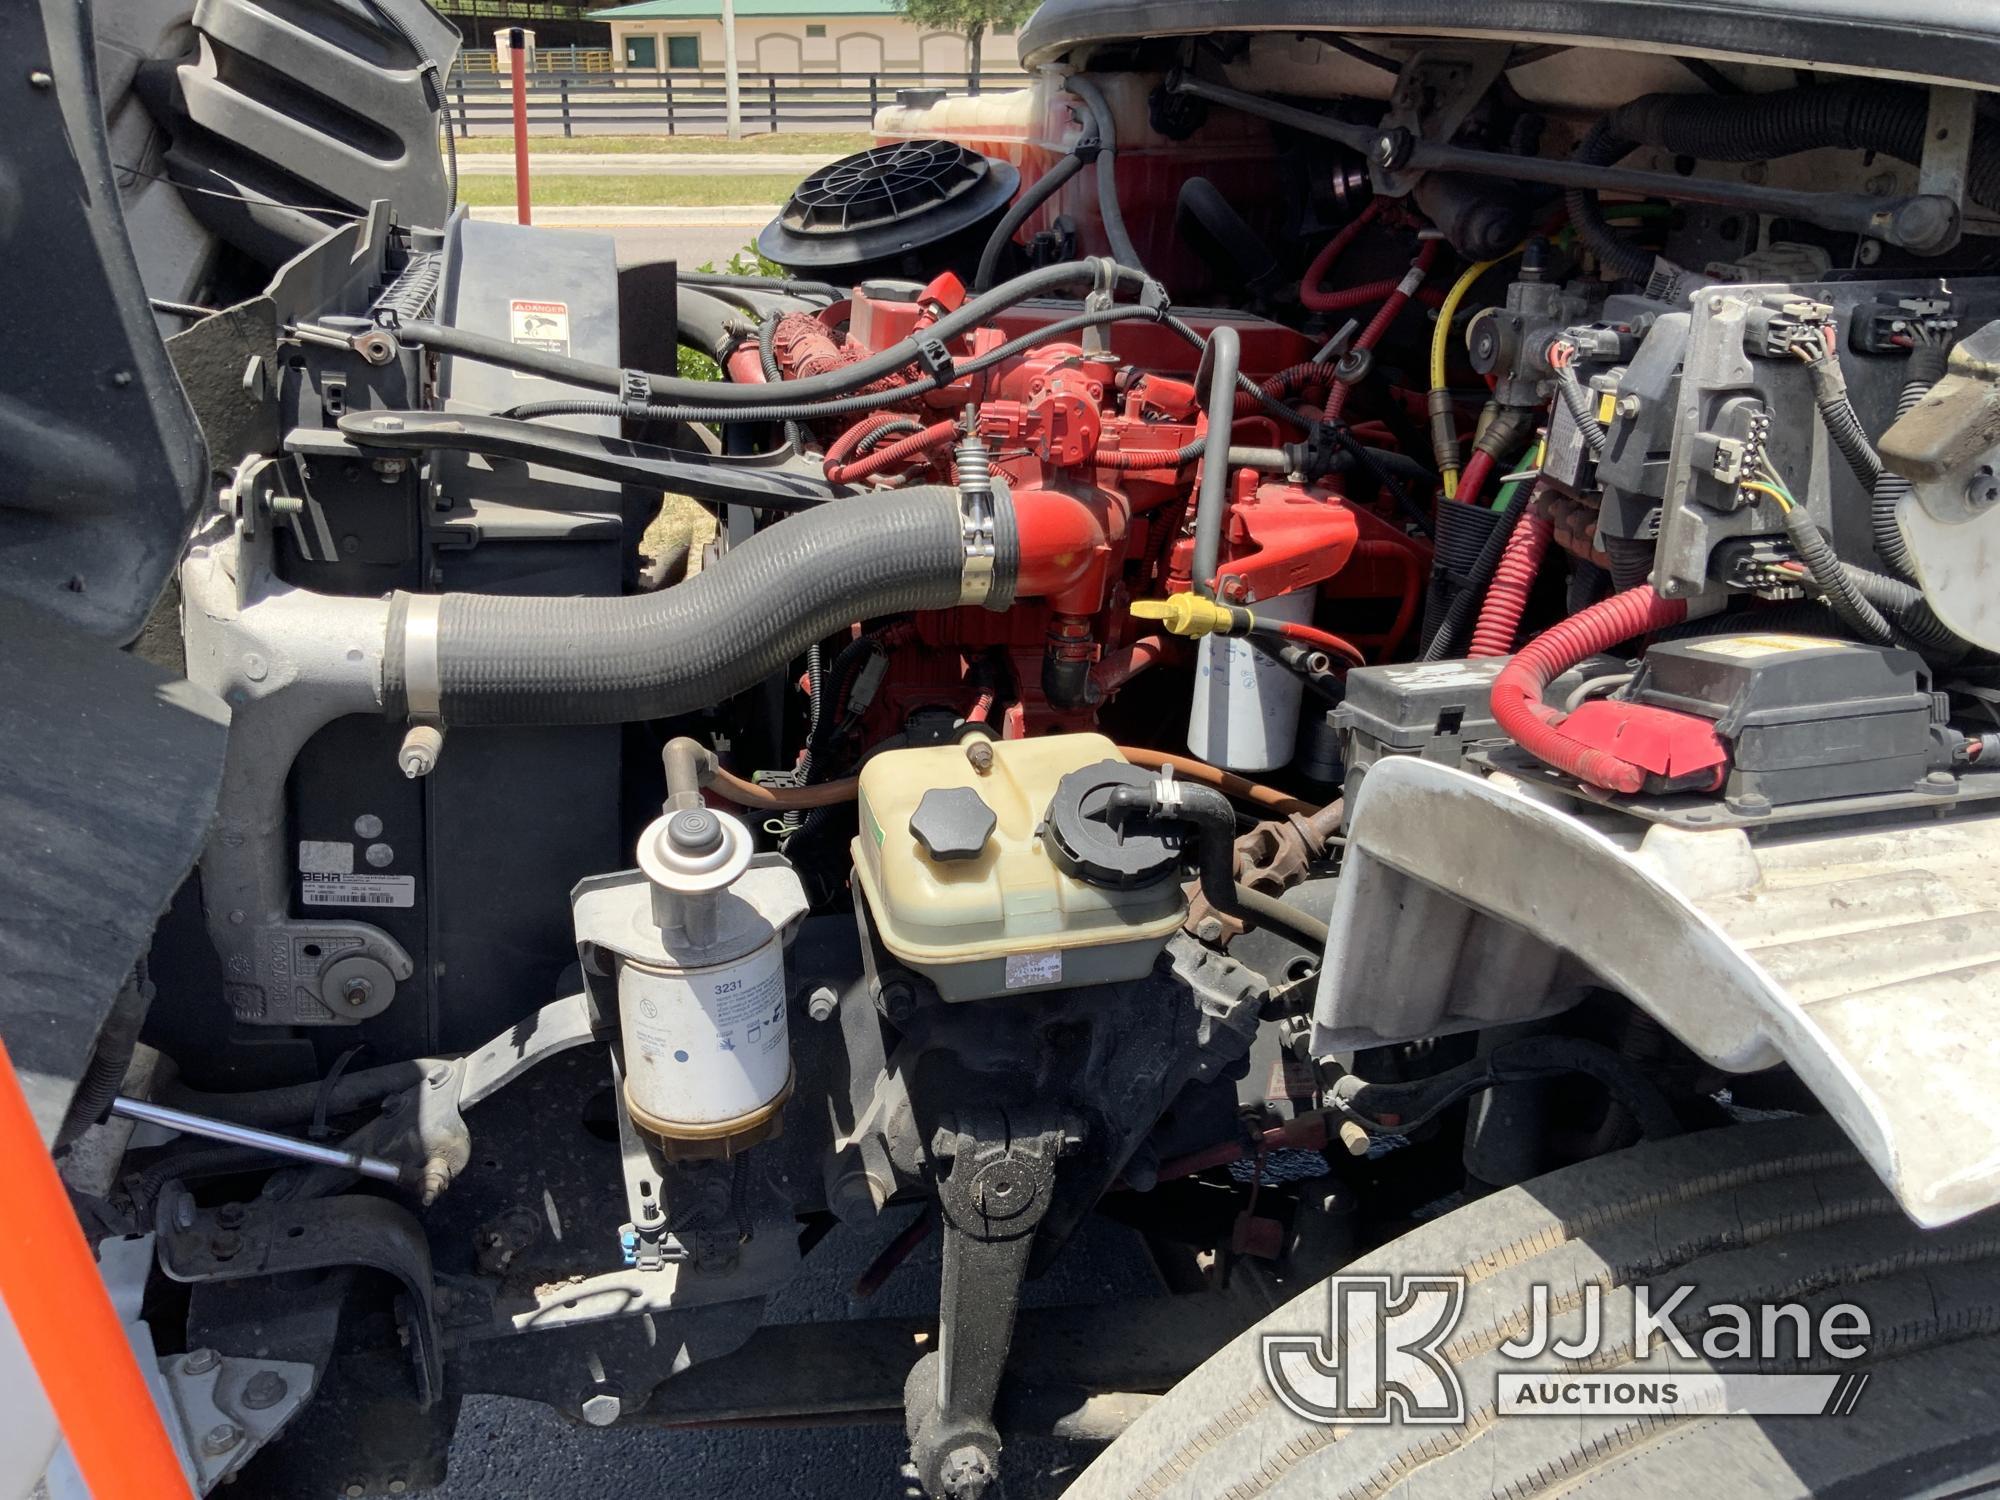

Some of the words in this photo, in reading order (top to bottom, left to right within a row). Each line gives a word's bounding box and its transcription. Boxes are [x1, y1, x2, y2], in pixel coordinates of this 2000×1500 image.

[525, 304, 564, 313] DANGER
[302, 872, 341, 882] BEHR
[714, 979, 742, 995] 3231
